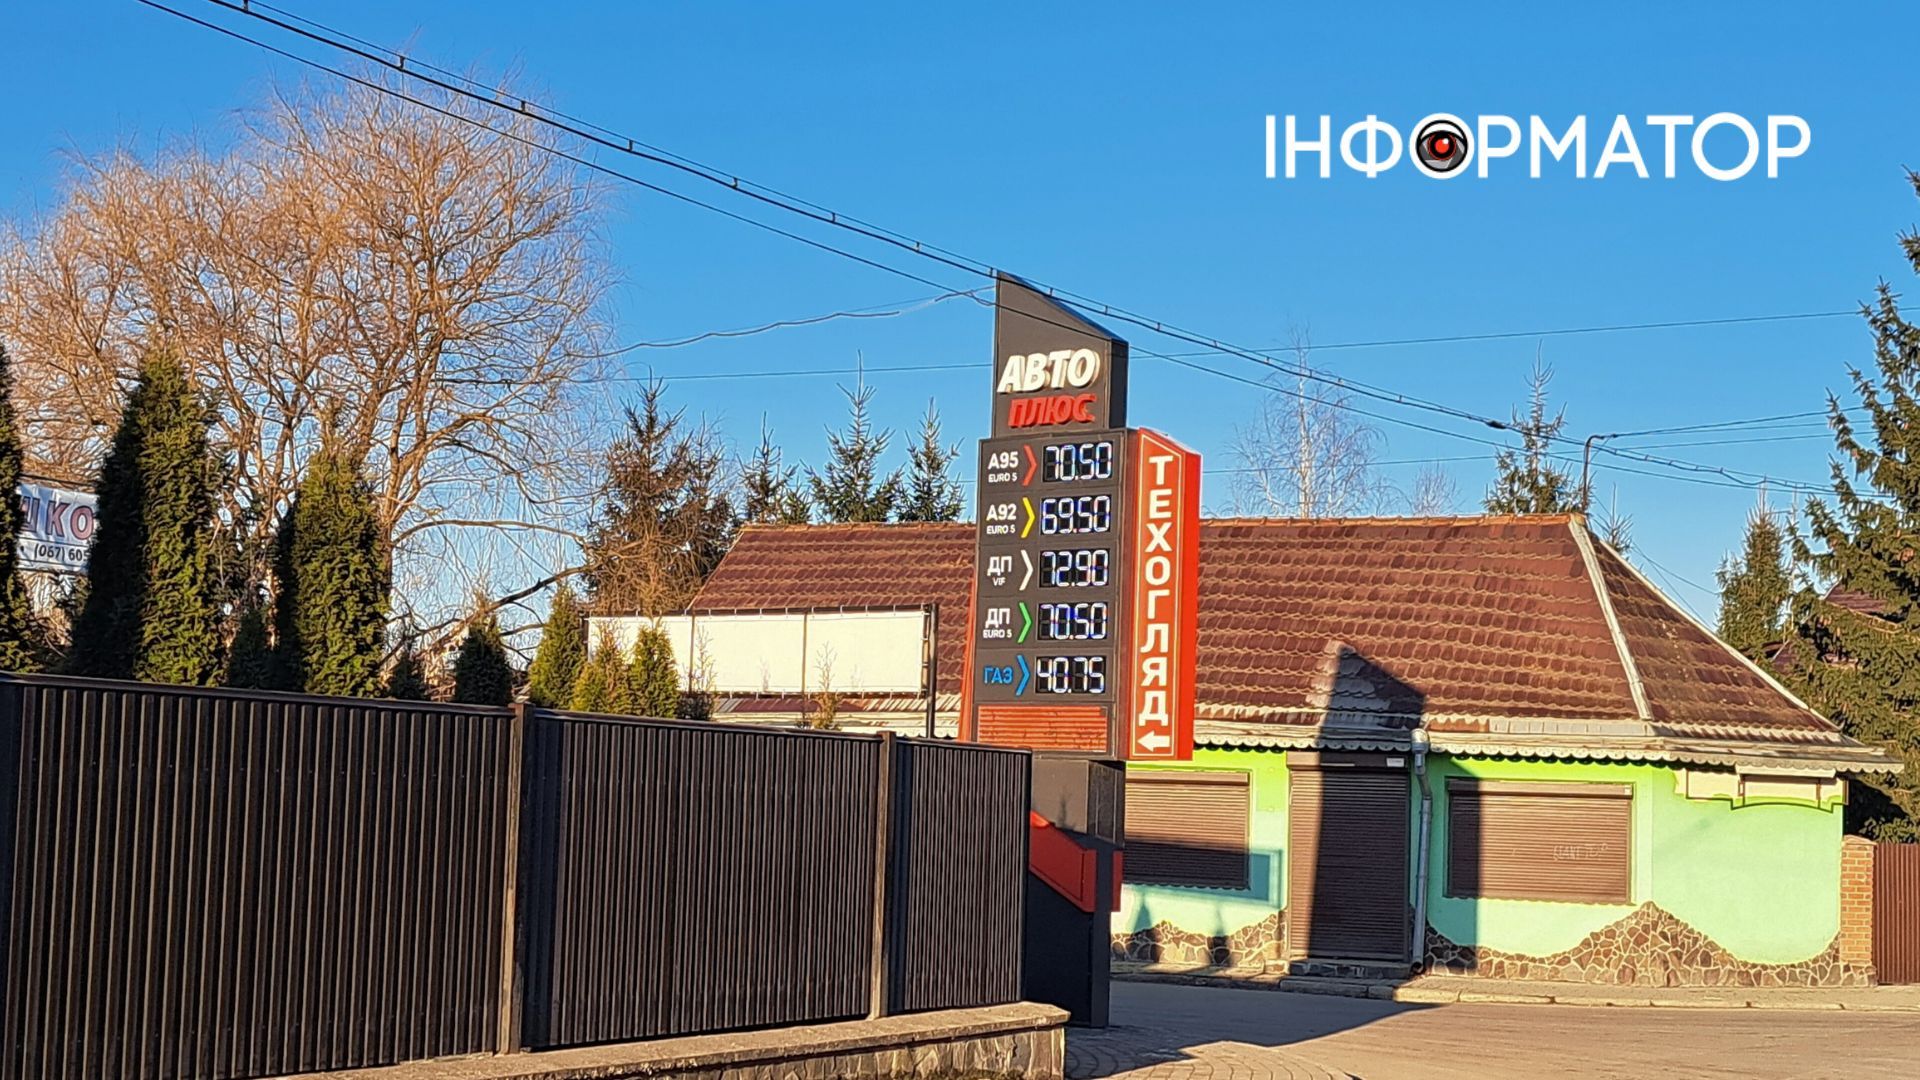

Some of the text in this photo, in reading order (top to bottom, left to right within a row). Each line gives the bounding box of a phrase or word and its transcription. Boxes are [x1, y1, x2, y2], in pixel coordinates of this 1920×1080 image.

[997, 348, 1100, 393] АВТО
[1008, 393, 1097, 428] ПЛЮС
[987, 451, 1019, 470] А95
[1045, 442, 1112, 480] 70.50
[988, 472, 1018, 483] EURO 5
[986, 503, 1017, 521] А92
[1041, 495, 1110, 534] 69.50
[986, 524, 1016, 535] EURO 5
[34, 543, 65, 562] (067)
[987, 555, 1013, 577] ДП
[1041, 549, 1108, 587] 72.90
[1140, 455, 1174, 726] ТЕХОГЛЯД
[985, 608, 1011, 629] ДП
[1040, 602, 1107, 640] 70.50
[983, 628, 1013, 639] EURO 5
[983, 666, 1014, 684] ГАЗ
[1036, 656, 1105, 694] 40.75
